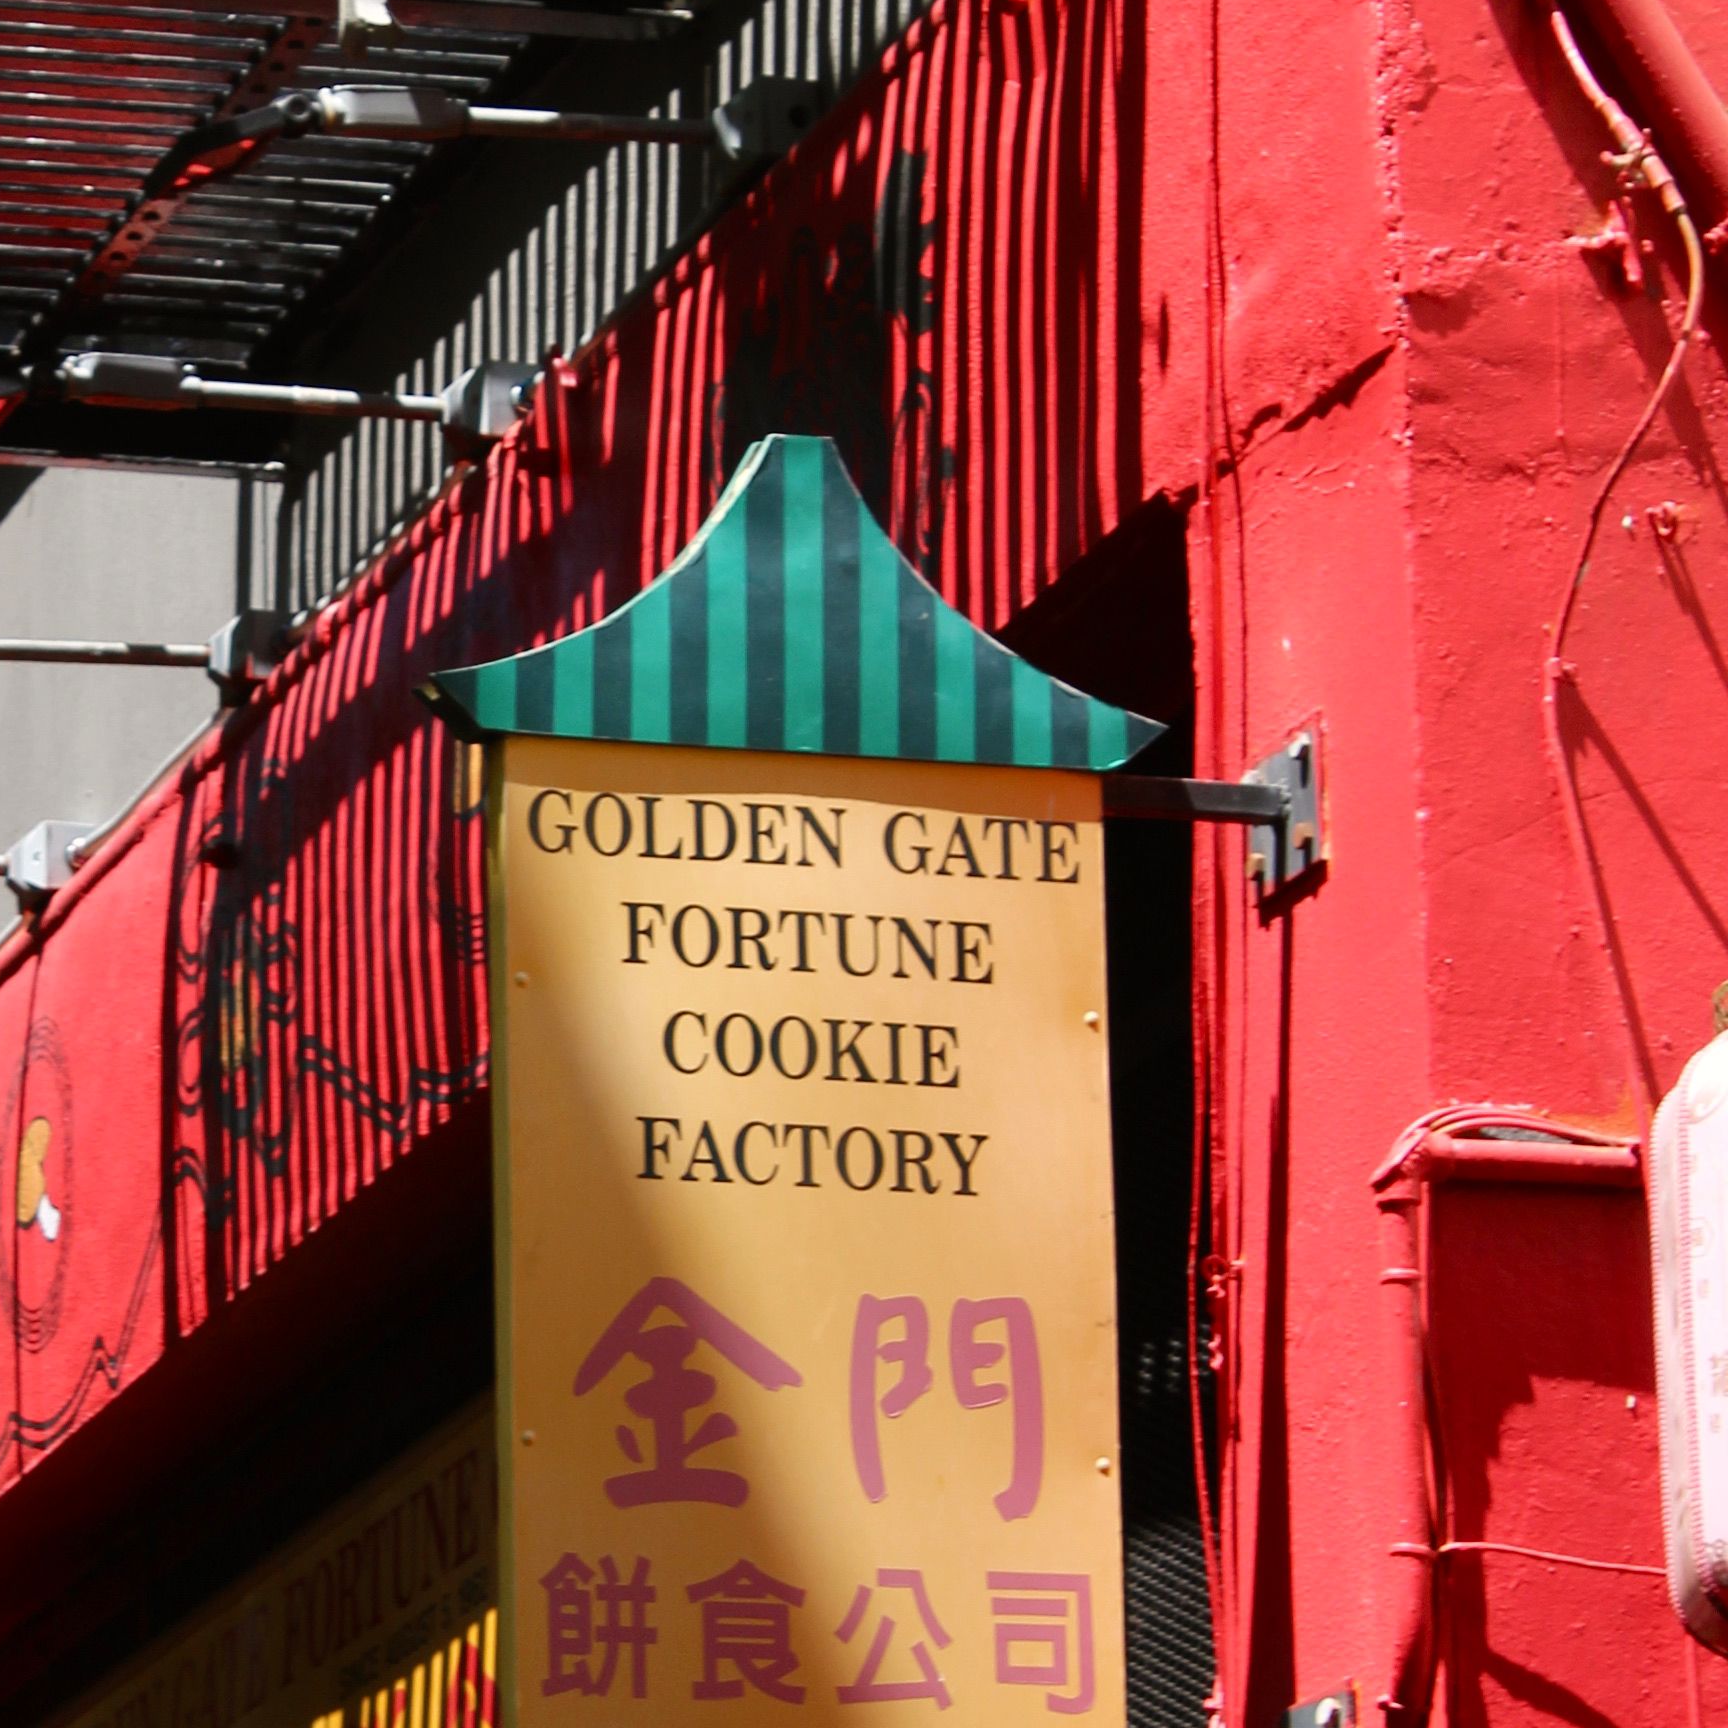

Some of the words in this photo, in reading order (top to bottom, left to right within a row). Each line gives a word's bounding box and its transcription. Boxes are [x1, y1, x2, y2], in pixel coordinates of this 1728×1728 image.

[528, 787, 846, 868] GOLDEN
[883, 810, 1080, 885] GATE
[620, 901, 994, 986] FORTUNE
[663, 1009, 960, 1090] COOKIE
[635, 1115, 989, 1198] FACTORY
[573, 1275, 1045, 1523] 金門
[540, 1550, 1096, 1715] 餅食公司
